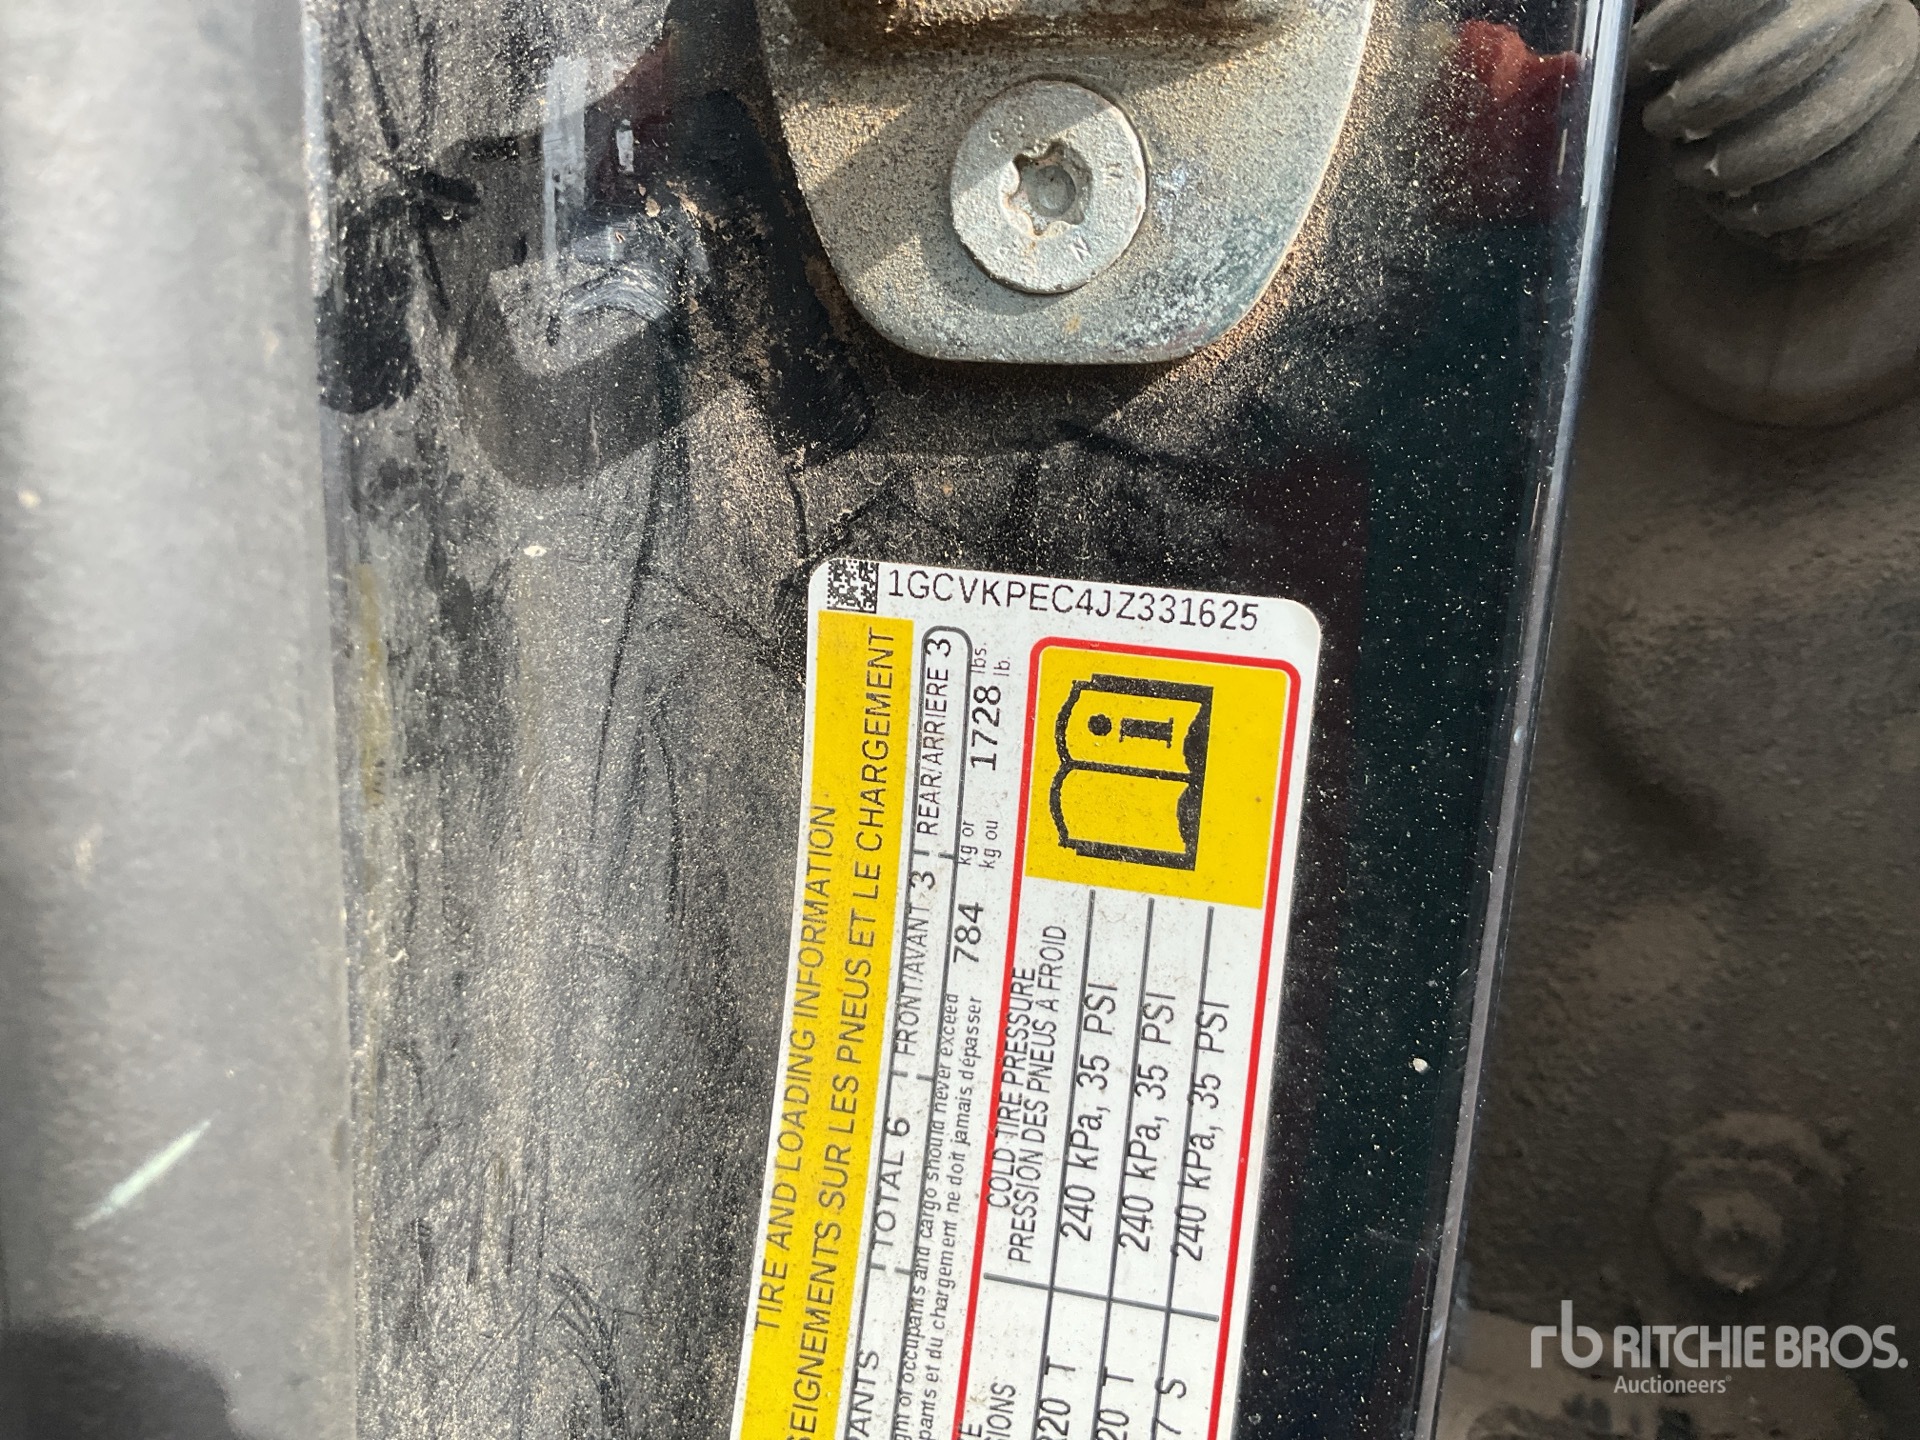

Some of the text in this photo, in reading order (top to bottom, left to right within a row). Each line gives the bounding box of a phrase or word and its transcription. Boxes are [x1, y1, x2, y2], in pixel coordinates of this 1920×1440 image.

[888, 568, 1260, 632] 1GCVKPEC4JZ331625
[924, 634, 951, 658] 3
[993, 654, 1011, 676] lb.
[855, 626, 894, 853] CHARGEMENT
[969, 681, 1001, 772] 1728
[957, 819, 979, 866] kg or
[980, 819, 1002, 870] kg ou
[851, 860, 880, 899] LE
[909, 868, 936, 890] 3
[847, 908, 876, 947] ET
[951, 899, 985, 966] 784
[1036, 923, 1067, 990] FROID
[835, 956, 872, 1063] PNEUS
[938, 992, 958, 1056] exceed
[1080, 981, 1117, 1035] PSI
[1140, 990, 1176, 1045] PSI
[1192, 997, 1229, 1054] PSI
[956, 995, 986, 1081] dépasser
[1025, 1018, 1057, 1093] PNEUS
[754, 804, 835, 1334] TIRE AND LOADING INFORMATION
[933, 1063, 951, 1112] never
[985, 965, 1036, 1209] COLD TIRE PRESSURE
[1074, 1051, 1110, 1091] 35
[1134, 1061, 1168, 1101] 35
[1186, 1070, 1222, 1110] 35
[827, 1072, 859, 1134] LES
[883, 1114, 911, 1138] 6
[949, 1084, 976, 1145] jamais
[1020, 1097, 1048, 1144] DES
[924, 1119, 944, 1181] should
[1066, 1101, 1110, 1172] kPa,
[1125, 1111, 1169, 1182] kPa,
[1177, 1120, 1222, 1192] kPa,
[817, 1142, 851, 1210] SUR
[944, 1150, 965, 1185] doit
[870, 1147, 904, 1252] TOTAL
[919, 1186, 942, 1239] cargo
[944, 1190, 960, 1213] ne
[1007, 1148, 1043, 1263] PRESSION
[1058, 1182, 1096, 1242] 240
[1117, 1192, 1154, 1252] 240
[1169, 1201, 1207, 1261] 240
[913, 1245, 931, 1279] and
[928, 1218, 961, 1331] chargement
[923, 1364, 940, 1382] et
[924, 1336, 943, 1358] du
[1043, 1355, 1076, 1379] T
[1101, 1366, 1134, 1390] T
[1154, 1375, 1187, 1399] S
